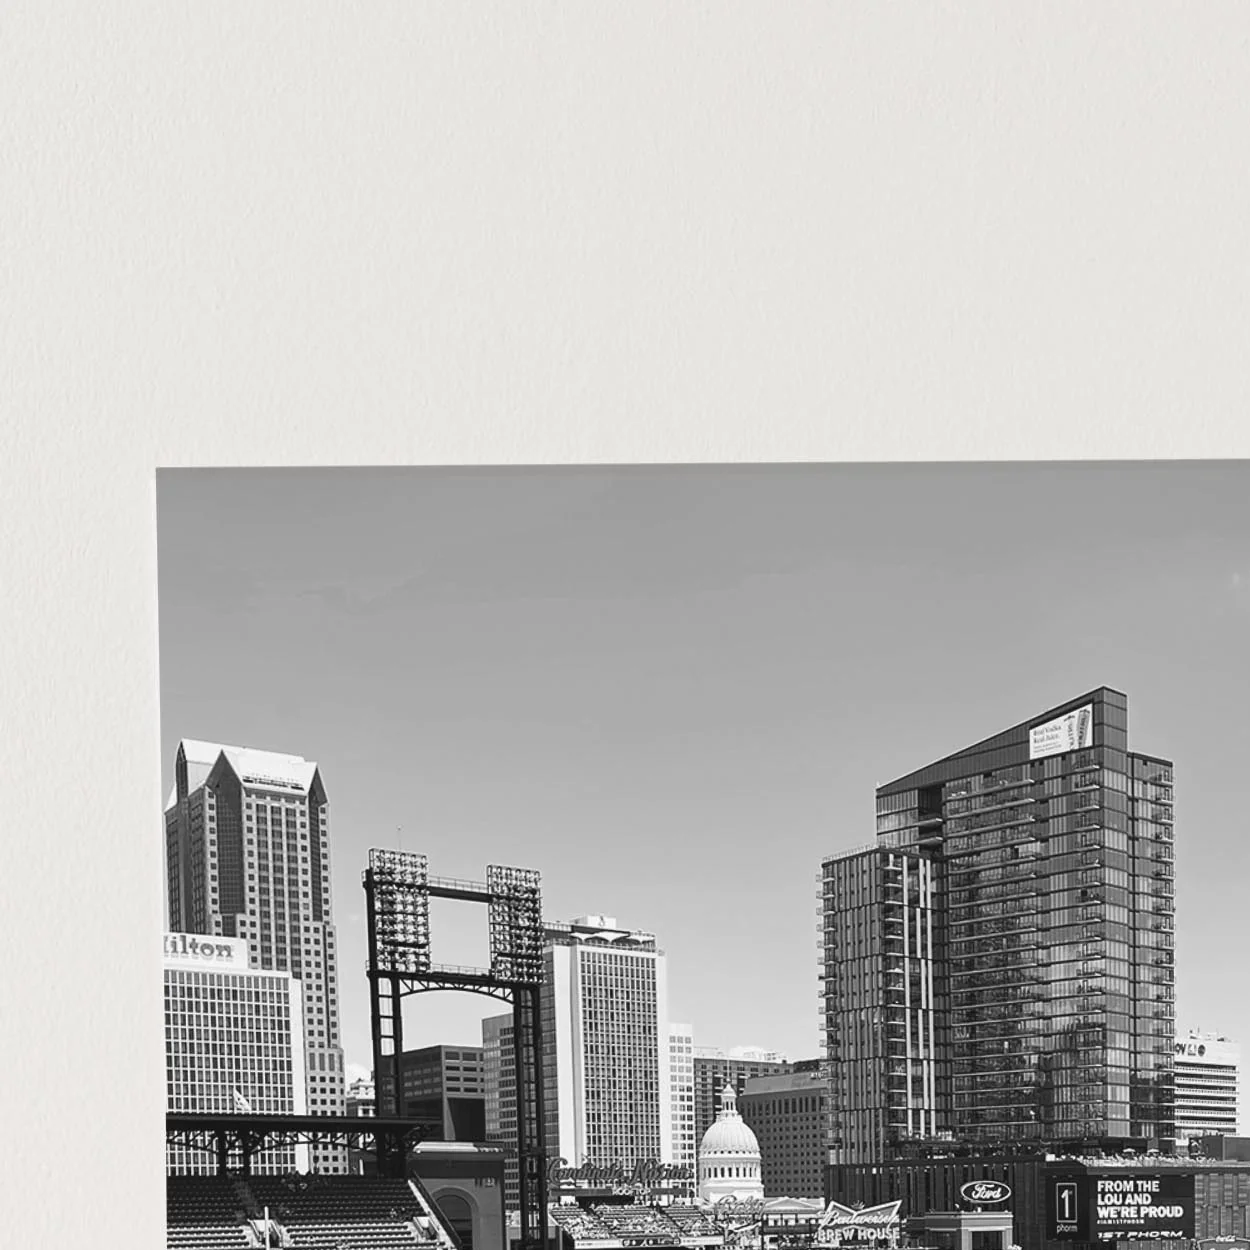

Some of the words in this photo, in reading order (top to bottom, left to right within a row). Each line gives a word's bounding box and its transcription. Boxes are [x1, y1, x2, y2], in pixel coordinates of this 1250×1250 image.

[972, 1184, 1002, 1199] Ford
[1097, 1180, 1134, 1192] FROM
[1136, 1180, 1160, 1192] THE
[1097, 1193, 1122, 1206] LOU
[1125, 1193, 1152, 1206] AND
[1097, 1206, 1138, 1218] WE'RE
[1140, 1206, 1184, 1218] PROUD
[818, 1228, 857, 1241] BREW
[858, 1228, 900, 1240] HOUSE
